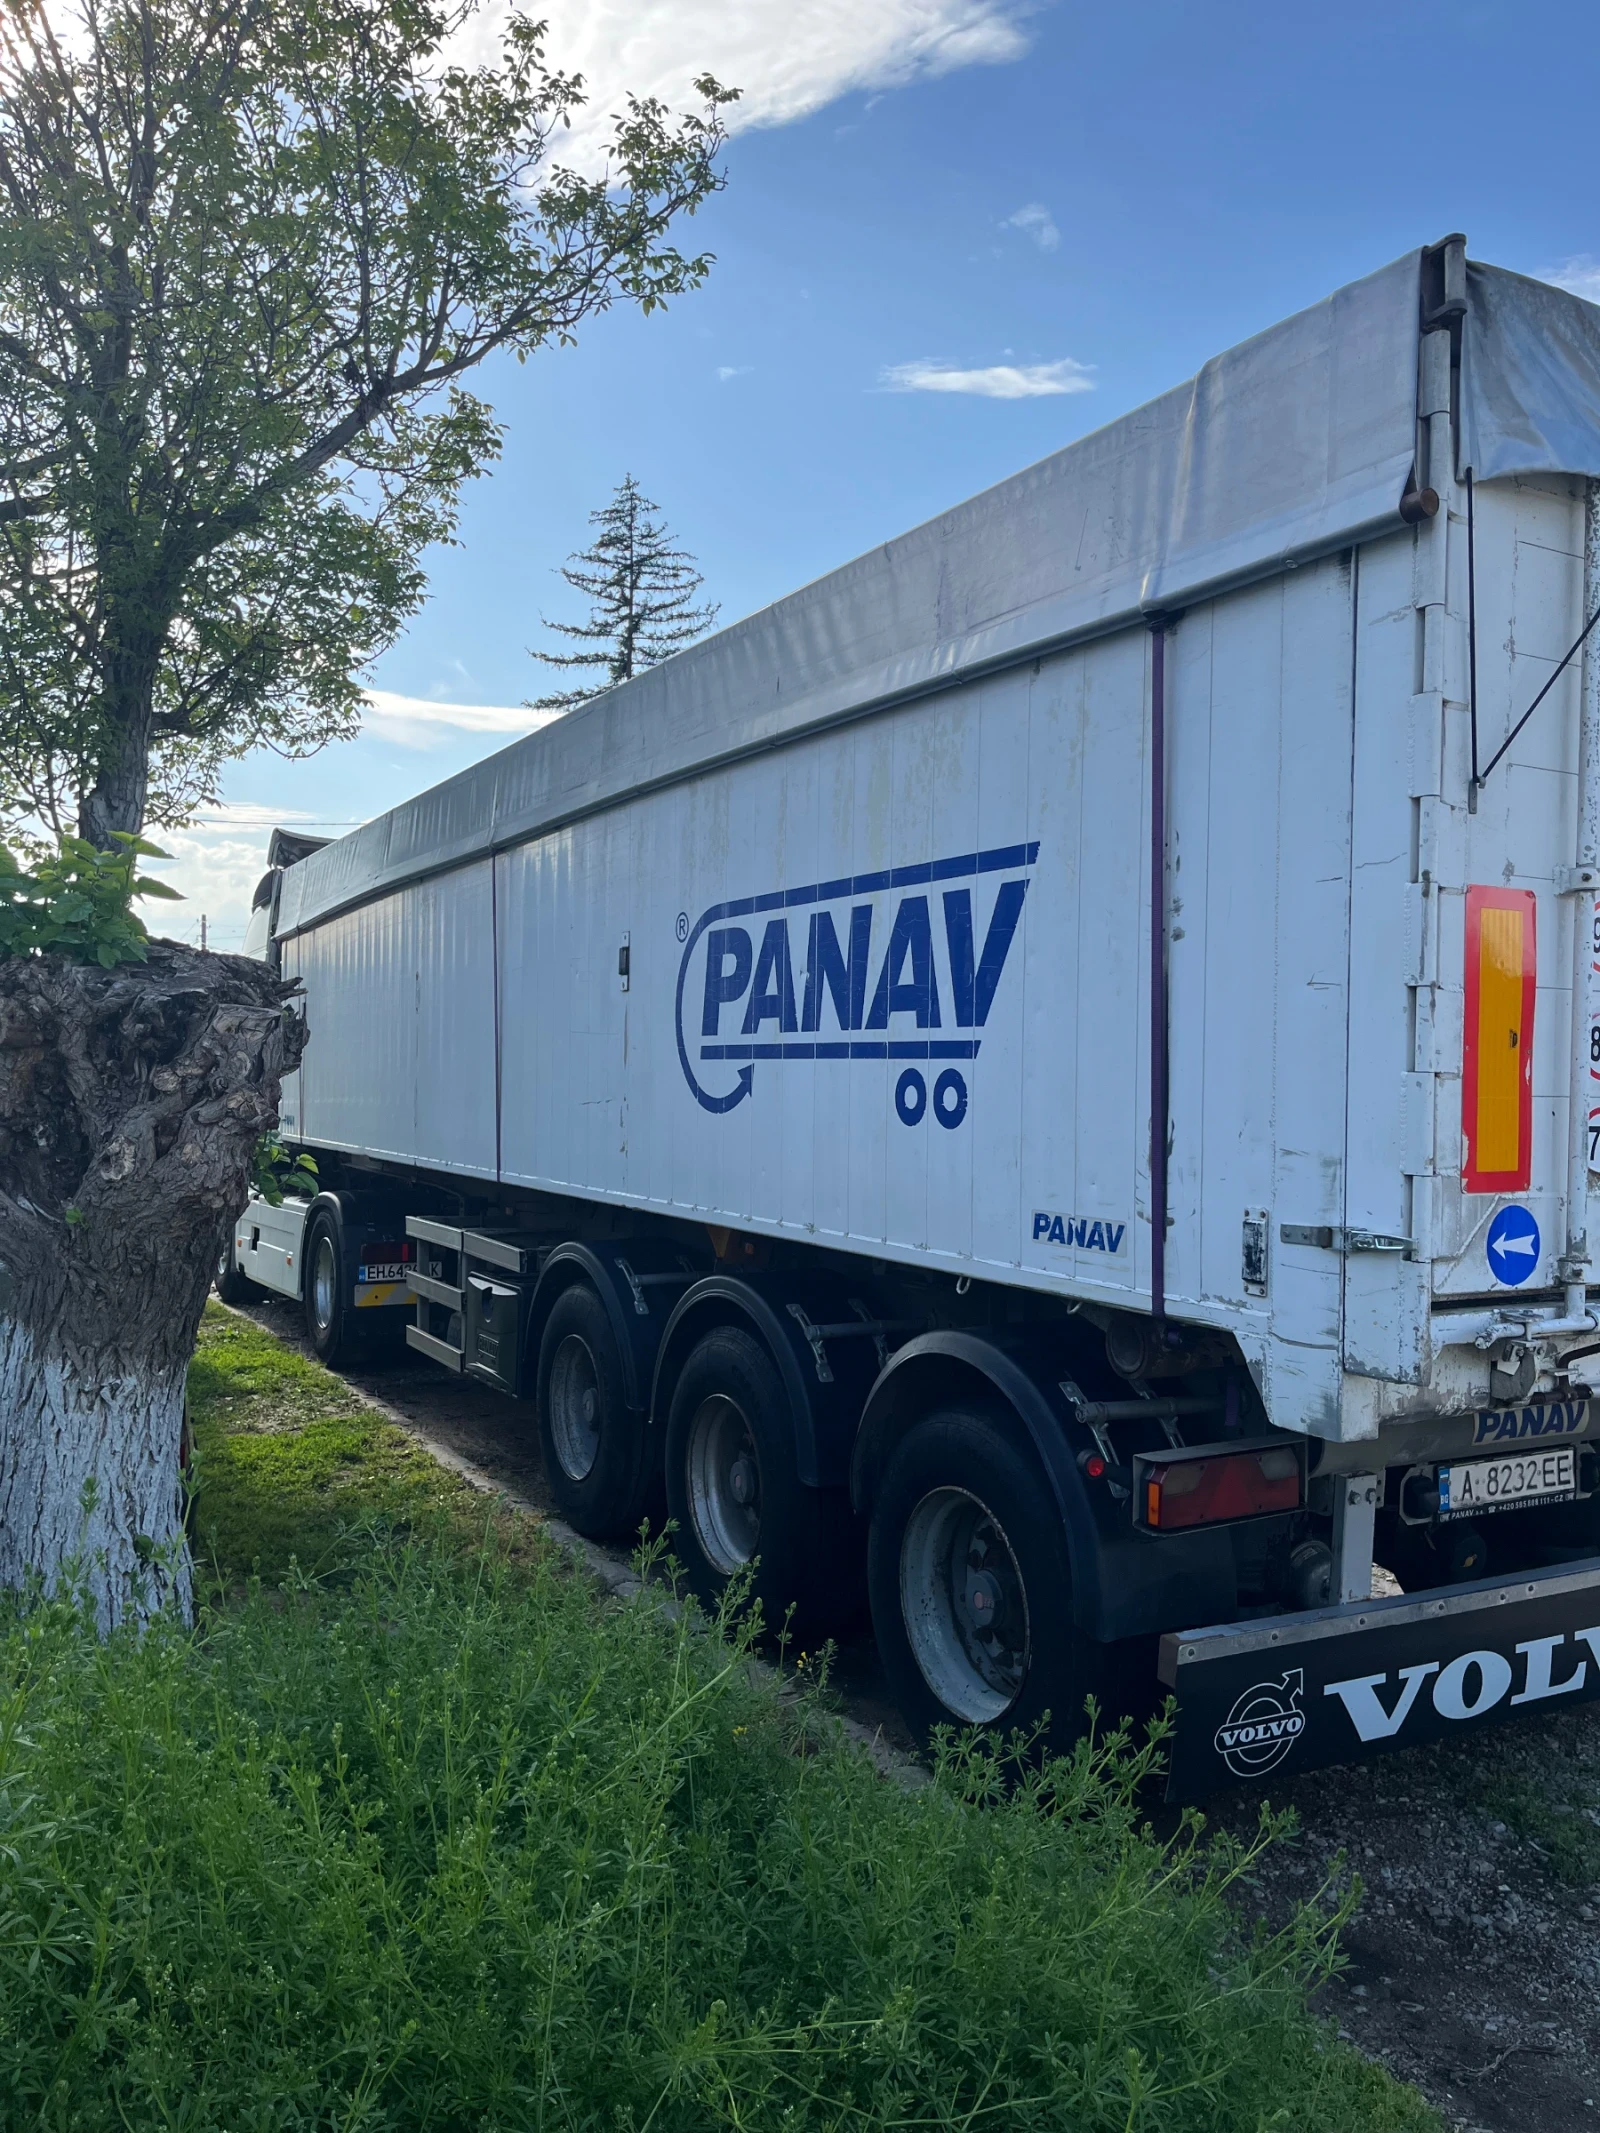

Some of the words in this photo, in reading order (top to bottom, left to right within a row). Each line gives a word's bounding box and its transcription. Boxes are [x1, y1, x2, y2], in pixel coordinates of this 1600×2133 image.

[701, 878, 1031, 1037] PANAV
[1032, 1212, 1126, 1253] PANAV
[1474, 1401, 1586, 1443] PANAV
[1451, 1508, 1474, 1520] PANAV
[1324, 1626, 1600, 1743] VOL
[1220, 1716, 1303, 1747] VOLVO
